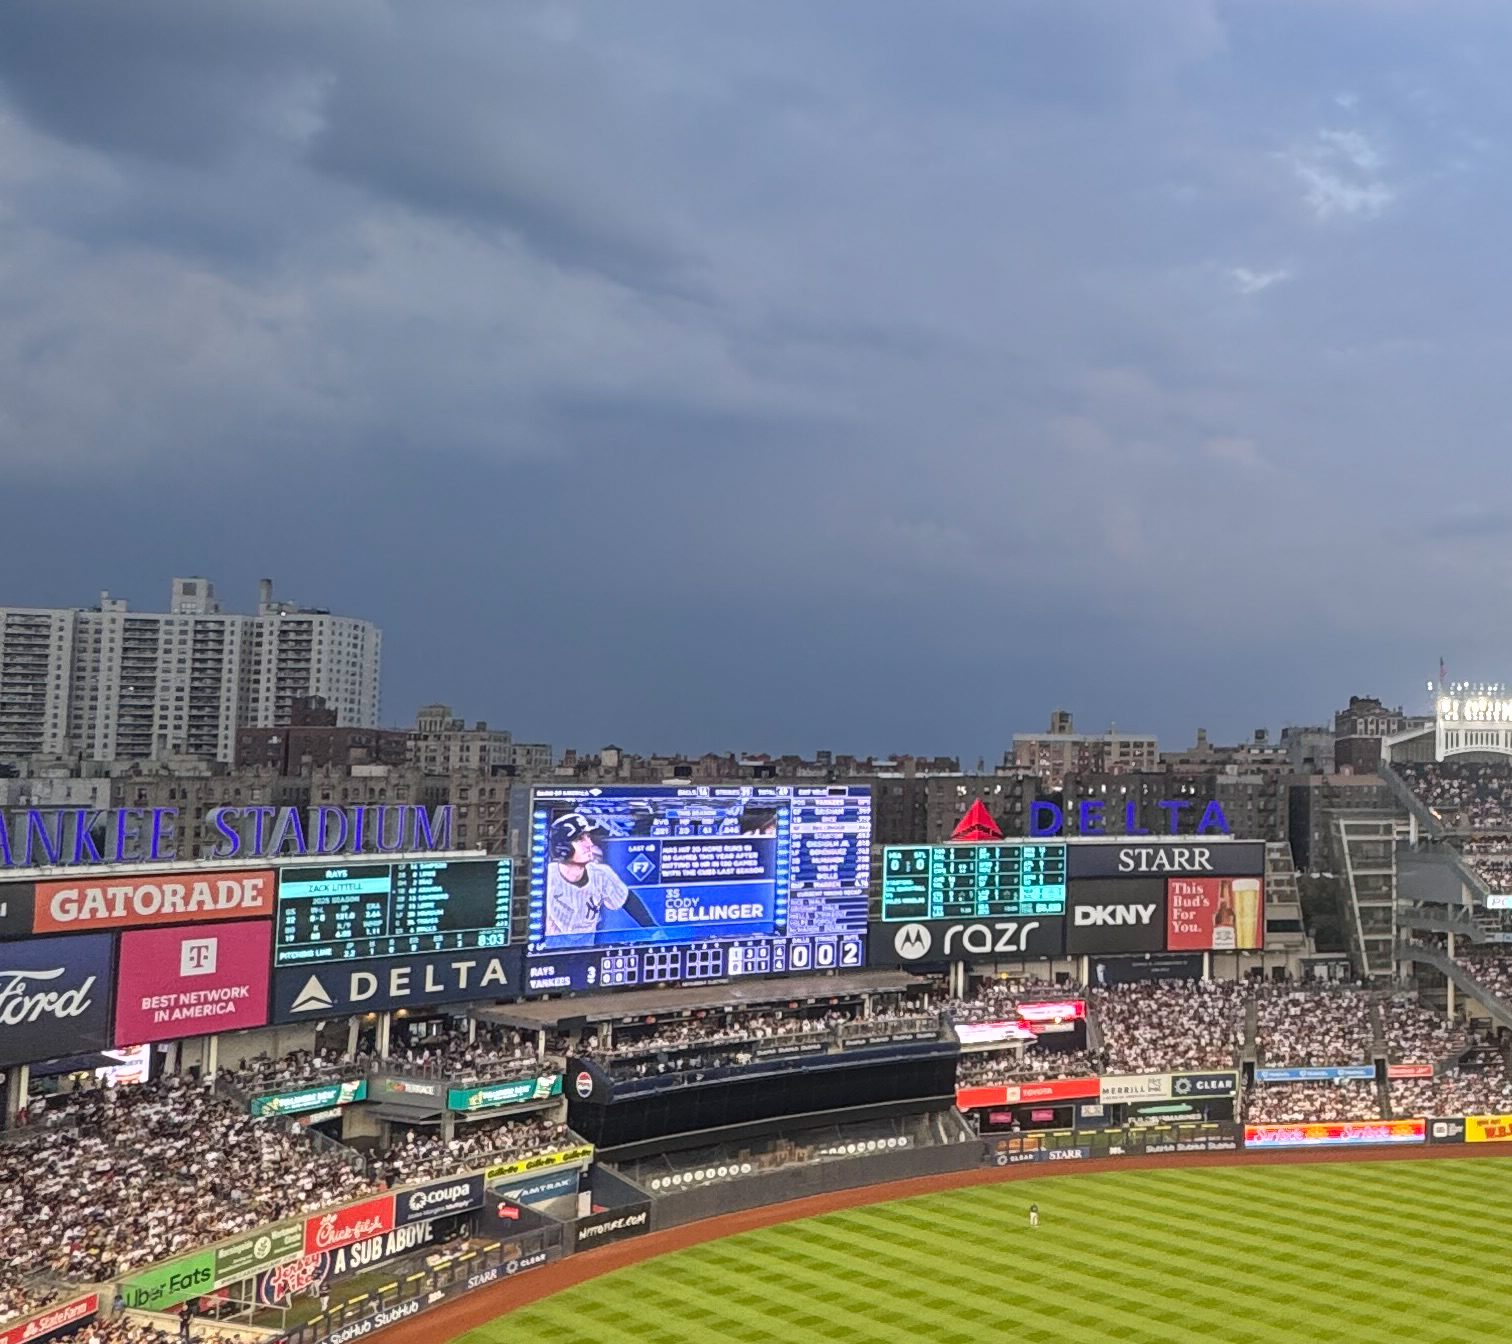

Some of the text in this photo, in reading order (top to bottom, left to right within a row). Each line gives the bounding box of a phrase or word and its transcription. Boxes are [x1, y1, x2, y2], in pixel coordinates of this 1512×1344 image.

[1029, 800, 1230, 837] DELTA
[211, 804, 457, 858] STADIUM
[628, 845, 645, 853] LAST
[1118, 848, 1213, 872] STARR
[325, 869, 348, 879] RAYS
[666, 888, 680, 898] 35
[1172, 882, 1204, 894] This
[50, 878, 263, 922] GATORADE
[665, 897, 699, 907] CODY
[1173, 894, 1210, 908] Bud's
[665, 904, 763, 923] BELLINGER
[1073, 904, 1156, 926] DKNY
[1172, 908, 1196, 920] For
[1172, 921, 1203, 934] You.
[477, 933, 504, 947] 8:03
[943, 921, 1040, 955] razr
[793, 943, 858, 967] 0 0 2
[350, 958, 508, 1002] DELTA
[530, 966, 555, 977] RAYS
[530, 977, 571, 989] YANKEES
[0, 967, 96, 1025] Ford
[142, 985, 249, 1010] BEST NETWORK
[154, 1001, 236, 1023] IN AMERICA
[1022, 1087, 1053, 1097] TOYOTA
[1102, 1087, 1145, 1095] MERRILL
[1196, 1079, 1233, 1090] CLEAR
[1049, 1149, 1082, 1160] STARR
[427, 1183, 470, 1204] coupa
[521, 1179, 570, 1197] AMTRAK
[578, 1212, 647, 1241] NITTOTIRE.COM
[334, 1249, 347, 1275] A
[350, 1237, 382, 1269] SUB
[386, 1221, 434, 1256] ABOVE
[520, 1254, 546, 1268] CLEAR
[126, 1282, 167, 1307] Uber
[169, 1267, 211, 1295] Eats
[468, 1269, 498, 1290] STARR
[374, 1300, 419, 1328] StubHub
